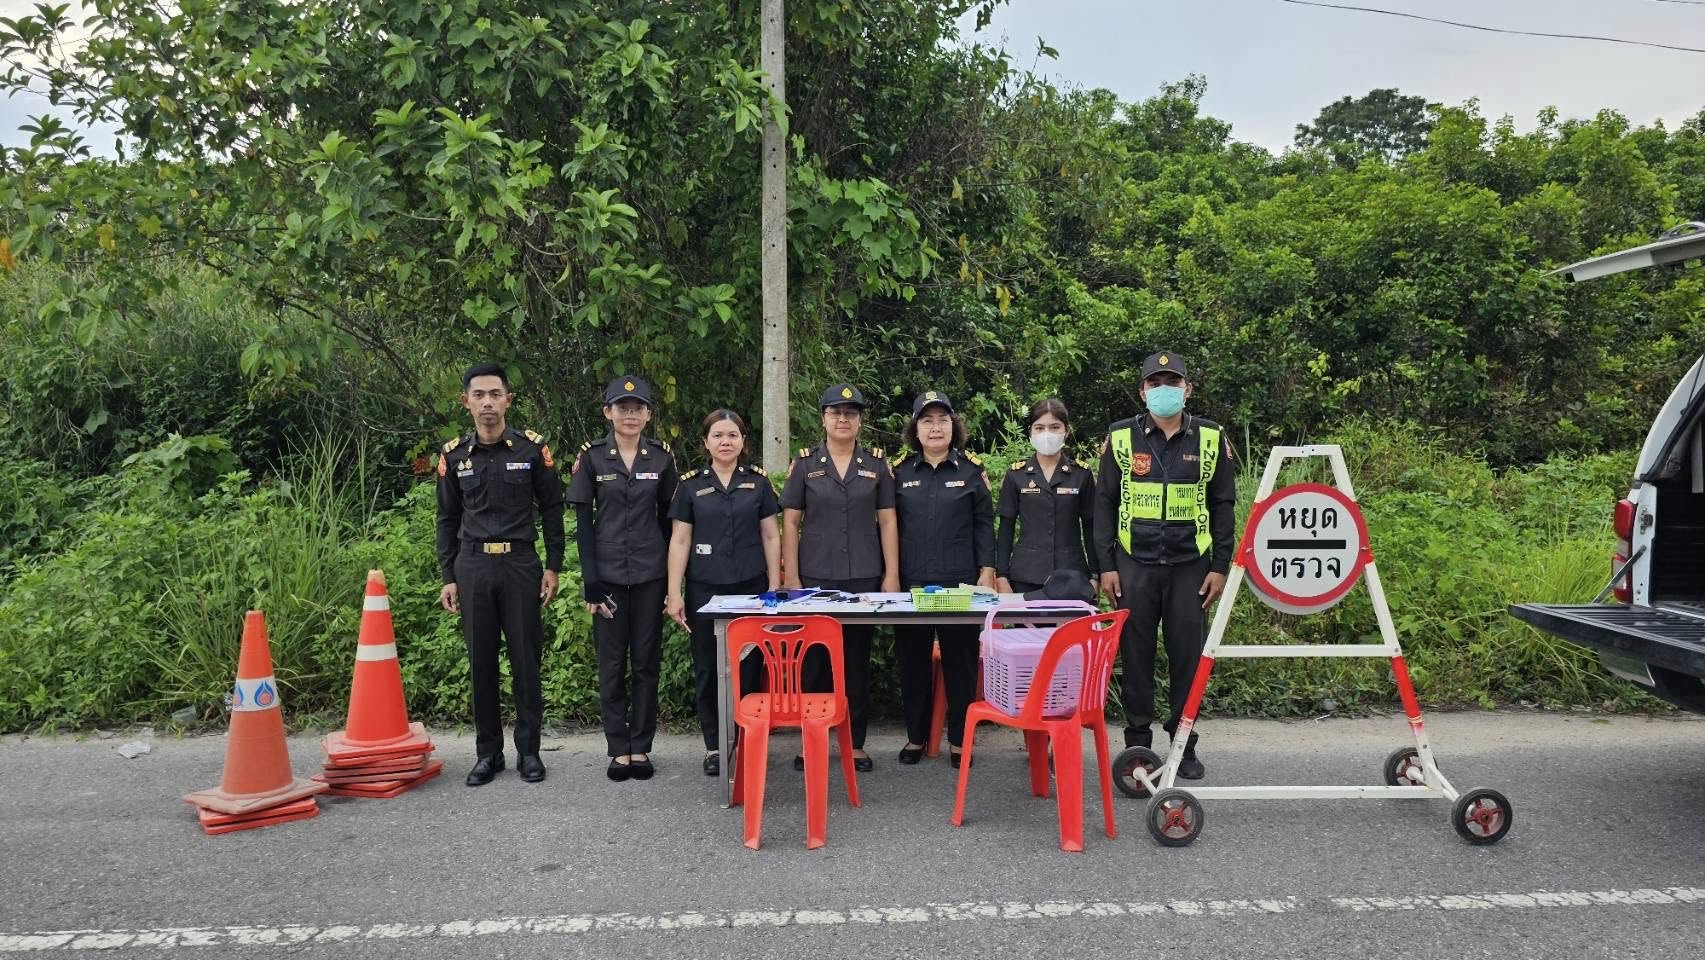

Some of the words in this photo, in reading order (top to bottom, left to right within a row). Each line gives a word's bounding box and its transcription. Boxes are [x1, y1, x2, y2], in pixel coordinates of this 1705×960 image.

[1116, 439, 1131, 533] INSPECTOR
[1196, 439, 1216, 535] INSPECTOR
[1278, 507, 1338, 538] หยุด
[1271, 557, 1341, 579] ตรวจ
